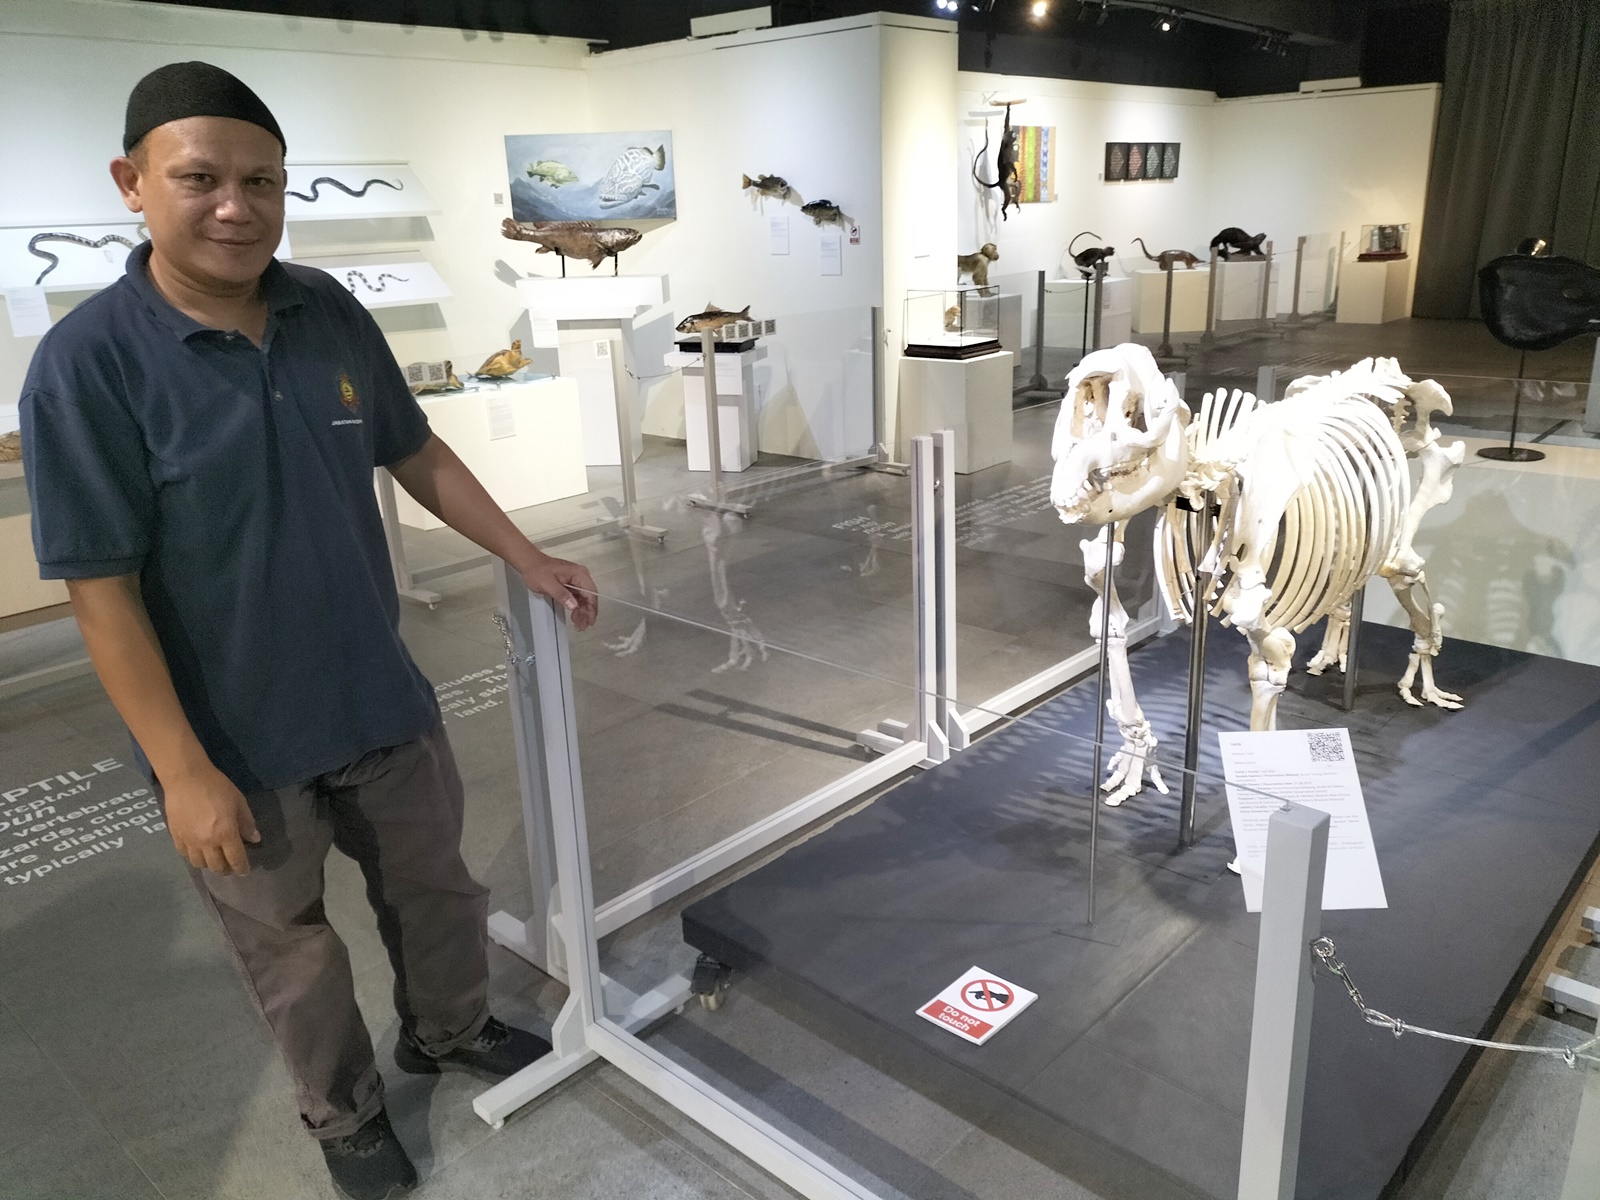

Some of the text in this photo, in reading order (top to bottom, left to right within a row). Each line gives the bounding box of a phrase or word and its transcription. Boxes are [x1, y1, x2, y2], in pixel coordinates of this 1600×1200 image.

[434, 669, 494, 691] cludes
[453, 699, 503, 718] land.
[0, 758, 124, 806] PTILE
[13, 788, 149, 837] vertebrate
[4, 836, 124, 885] typically
[939, 1012, 970, 1030] touch
[943, 1005, 981, 1027] Do not
